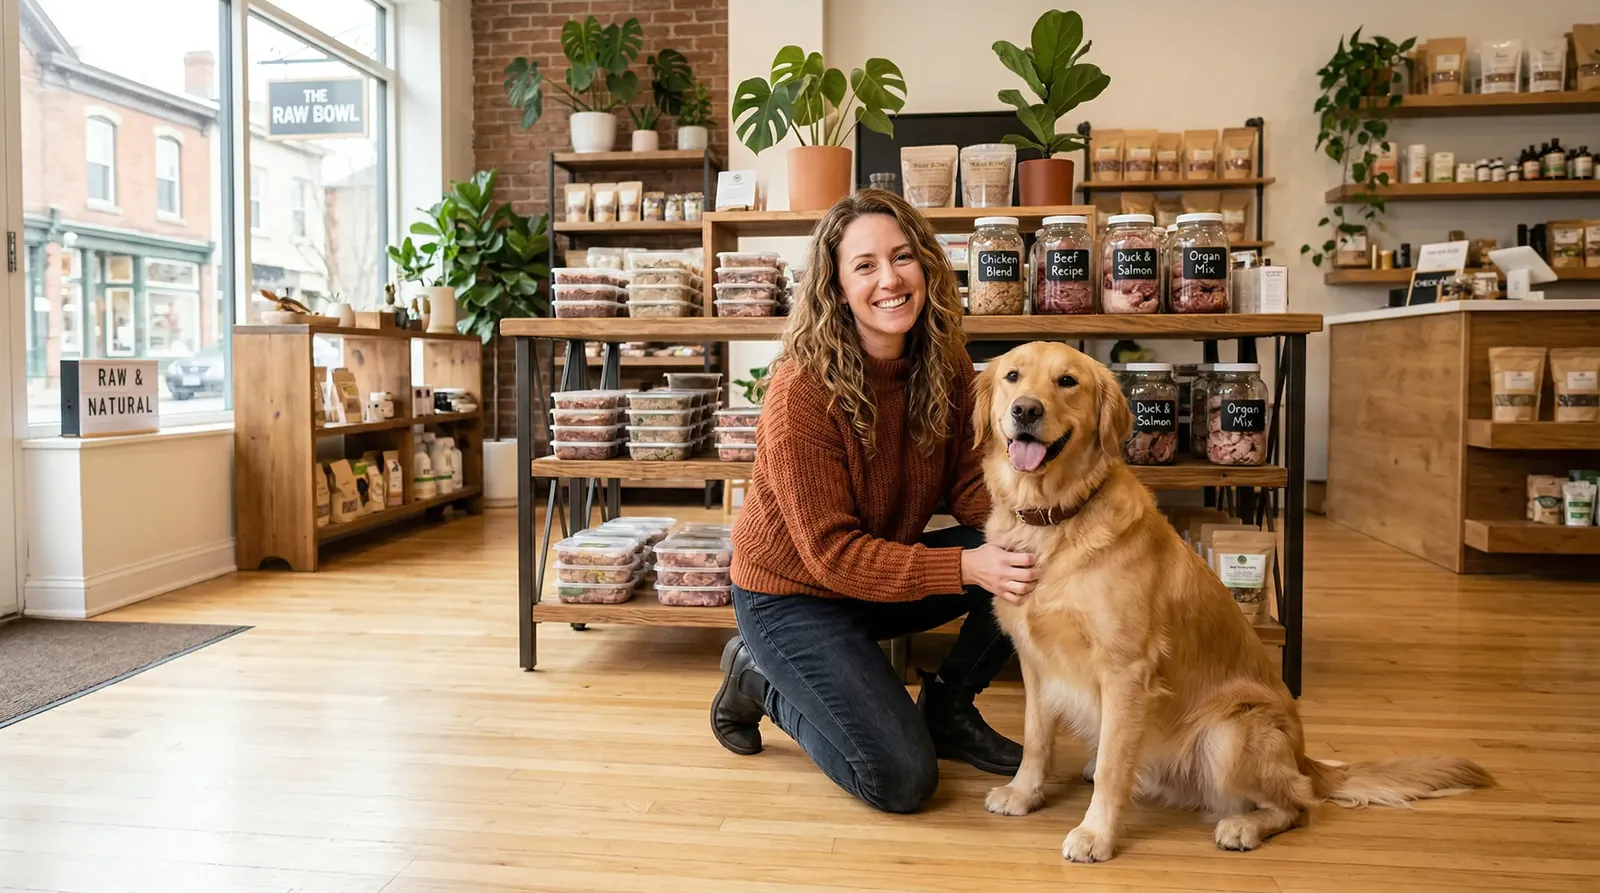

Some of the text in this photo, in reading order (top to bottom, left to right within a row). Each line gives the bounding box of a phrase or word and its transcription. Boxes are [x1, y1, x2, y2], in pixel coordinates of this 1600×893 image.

[303, 88, 328, 103] THE
[272, 103, 360, 124] RAW BOWL
[980, 253, 1018, 264] Chicken
[1053, 251, 1079, 263] Beef
[1117, 251, 1152, 262] Duck &
[1189, 250, 1220, 264] Organ
[986, 265, 1013, 277] Blend
[1051, 265, 1084, 279] Recipe
[1117, 264, 1153, 276] Salmon
[1194, 264, 1215, 274] Mix
[98, 368, 143, 386] RAW &
[88, 395, 153, 416] NATURAL
[1136, 402, 1171, 414] Duck &
[1227, 402, 1259, 418] Organ
[1137, 414, 1171, 426] Salmon
[1232, 416, 1253, 427] Mix
